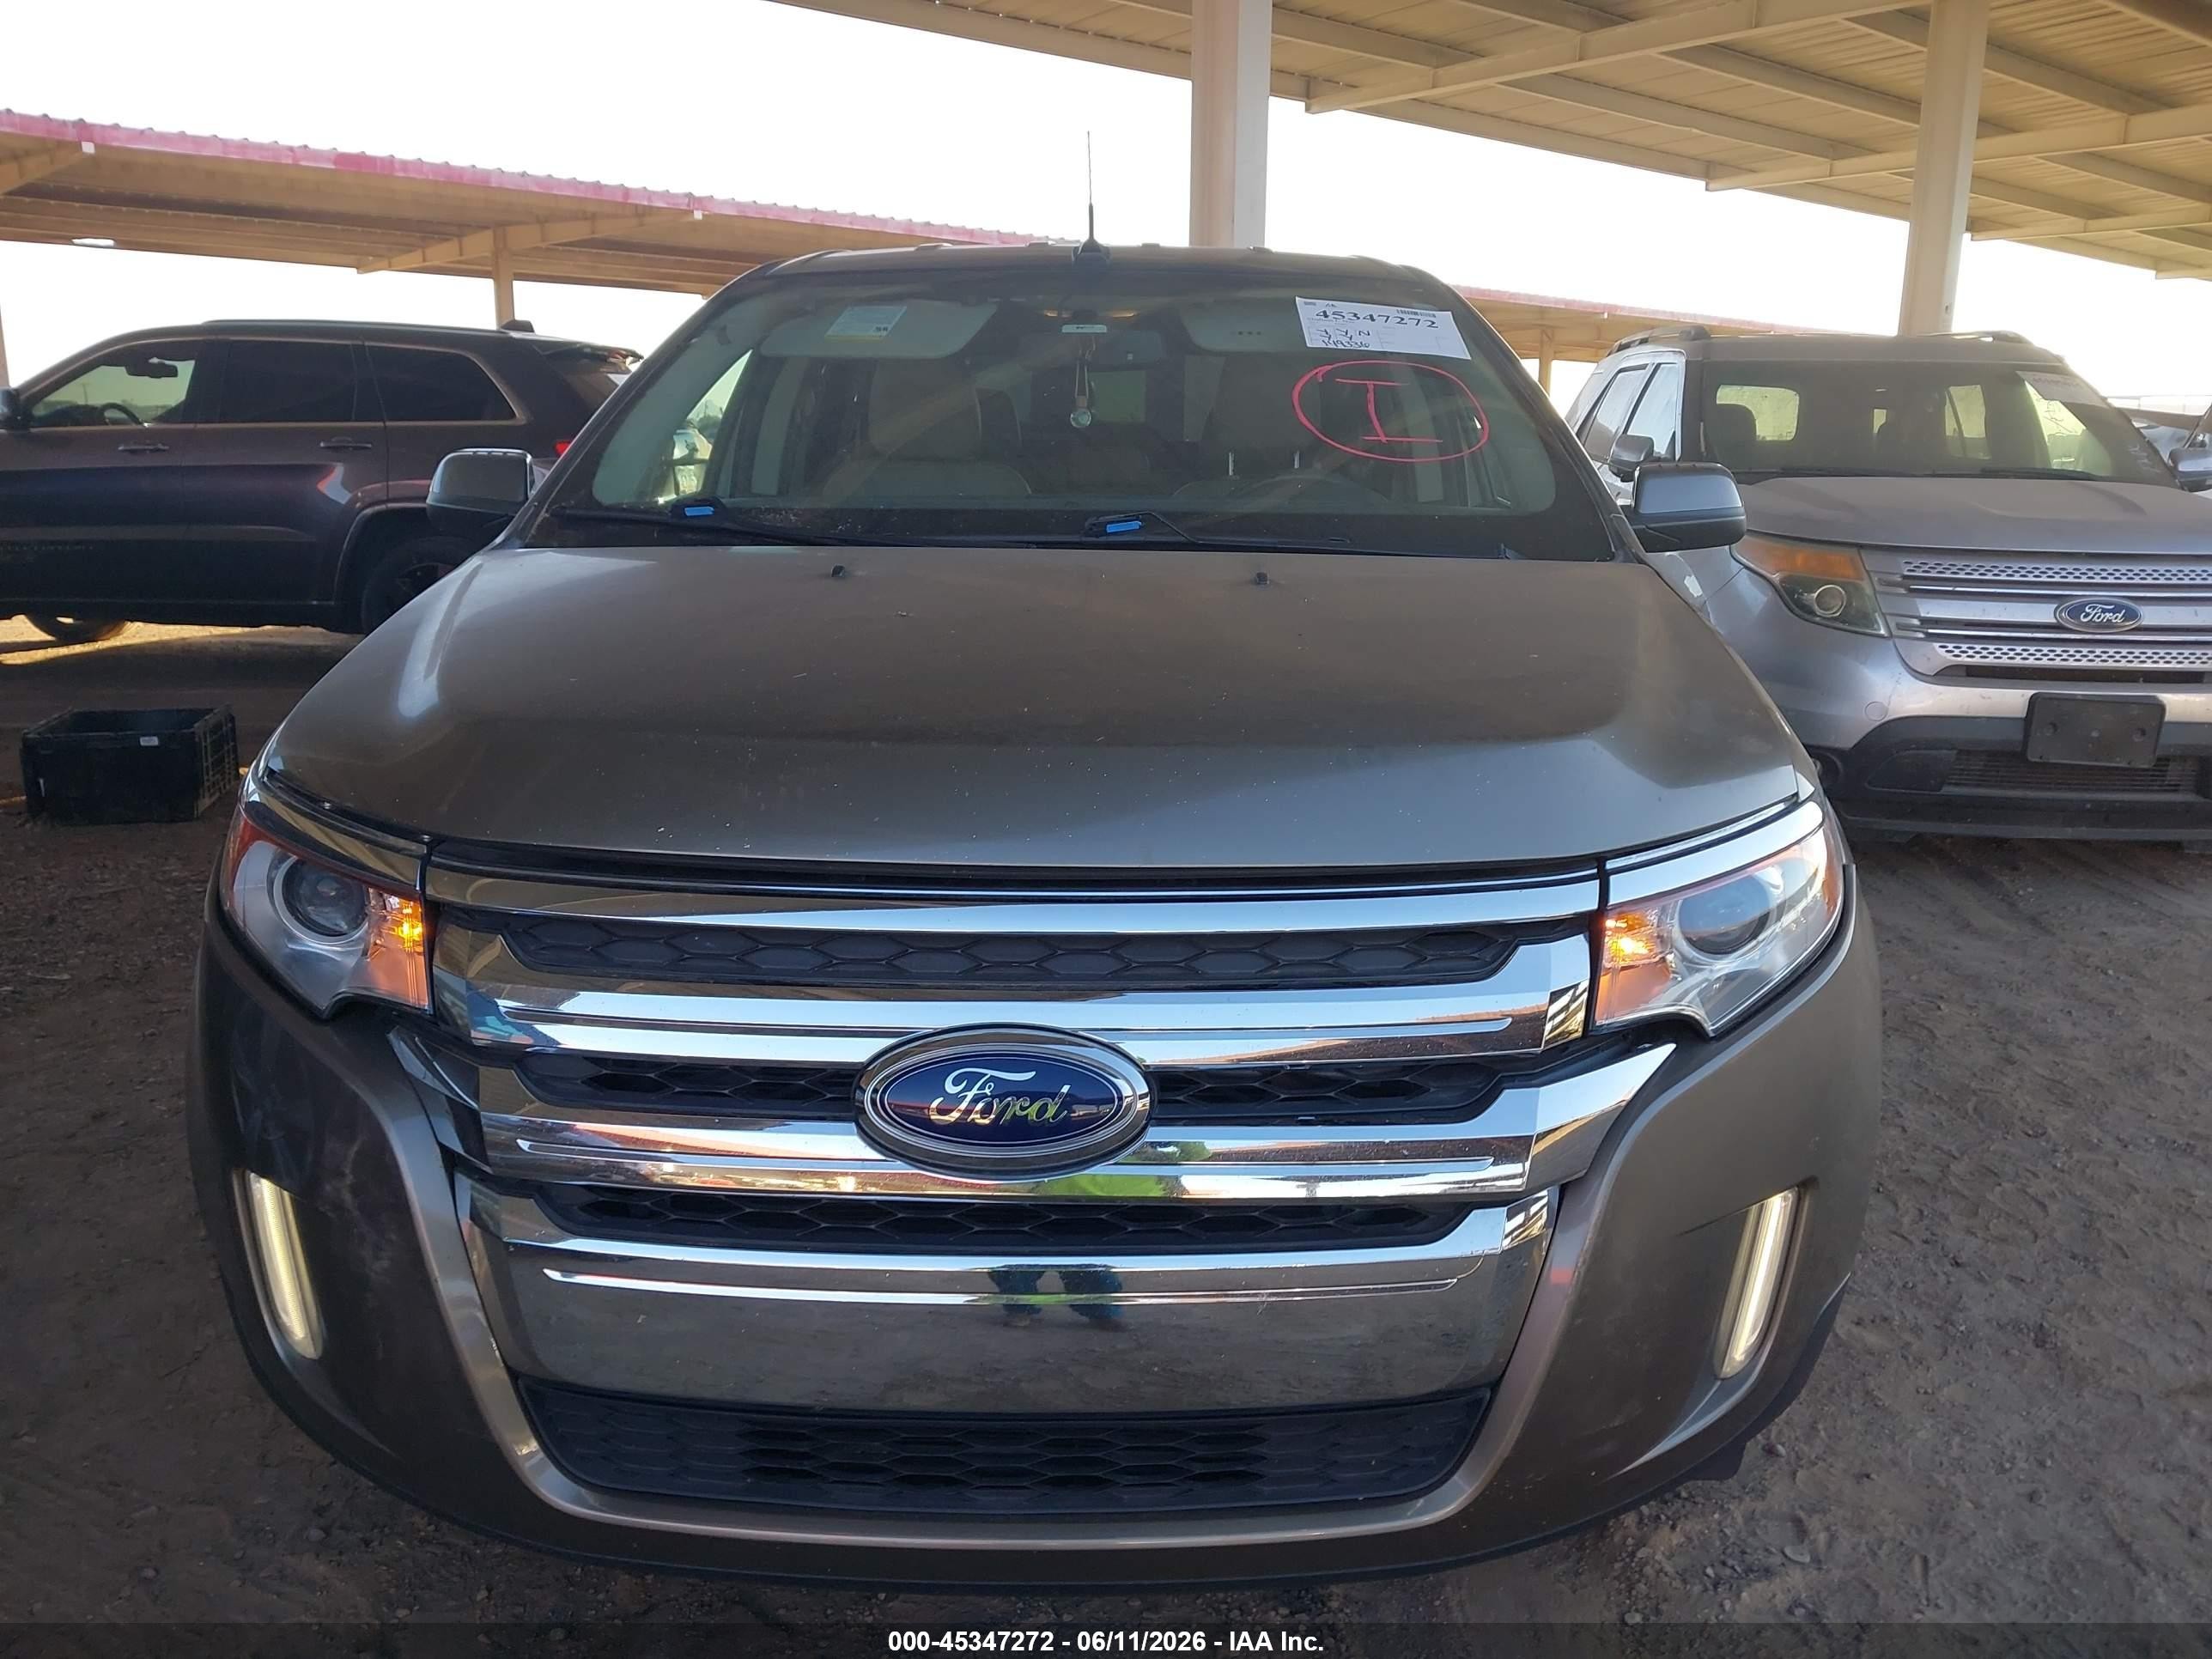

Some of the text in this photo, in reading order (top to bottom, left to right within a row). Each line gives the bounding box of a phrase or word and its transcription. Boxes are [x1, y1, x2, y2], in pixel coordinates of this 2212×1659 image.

[1316, 310, 1439, 329] 45347272
[2081, 604, 2126, 623] Ford
[929, 1067, 1072, 1126] Ford
